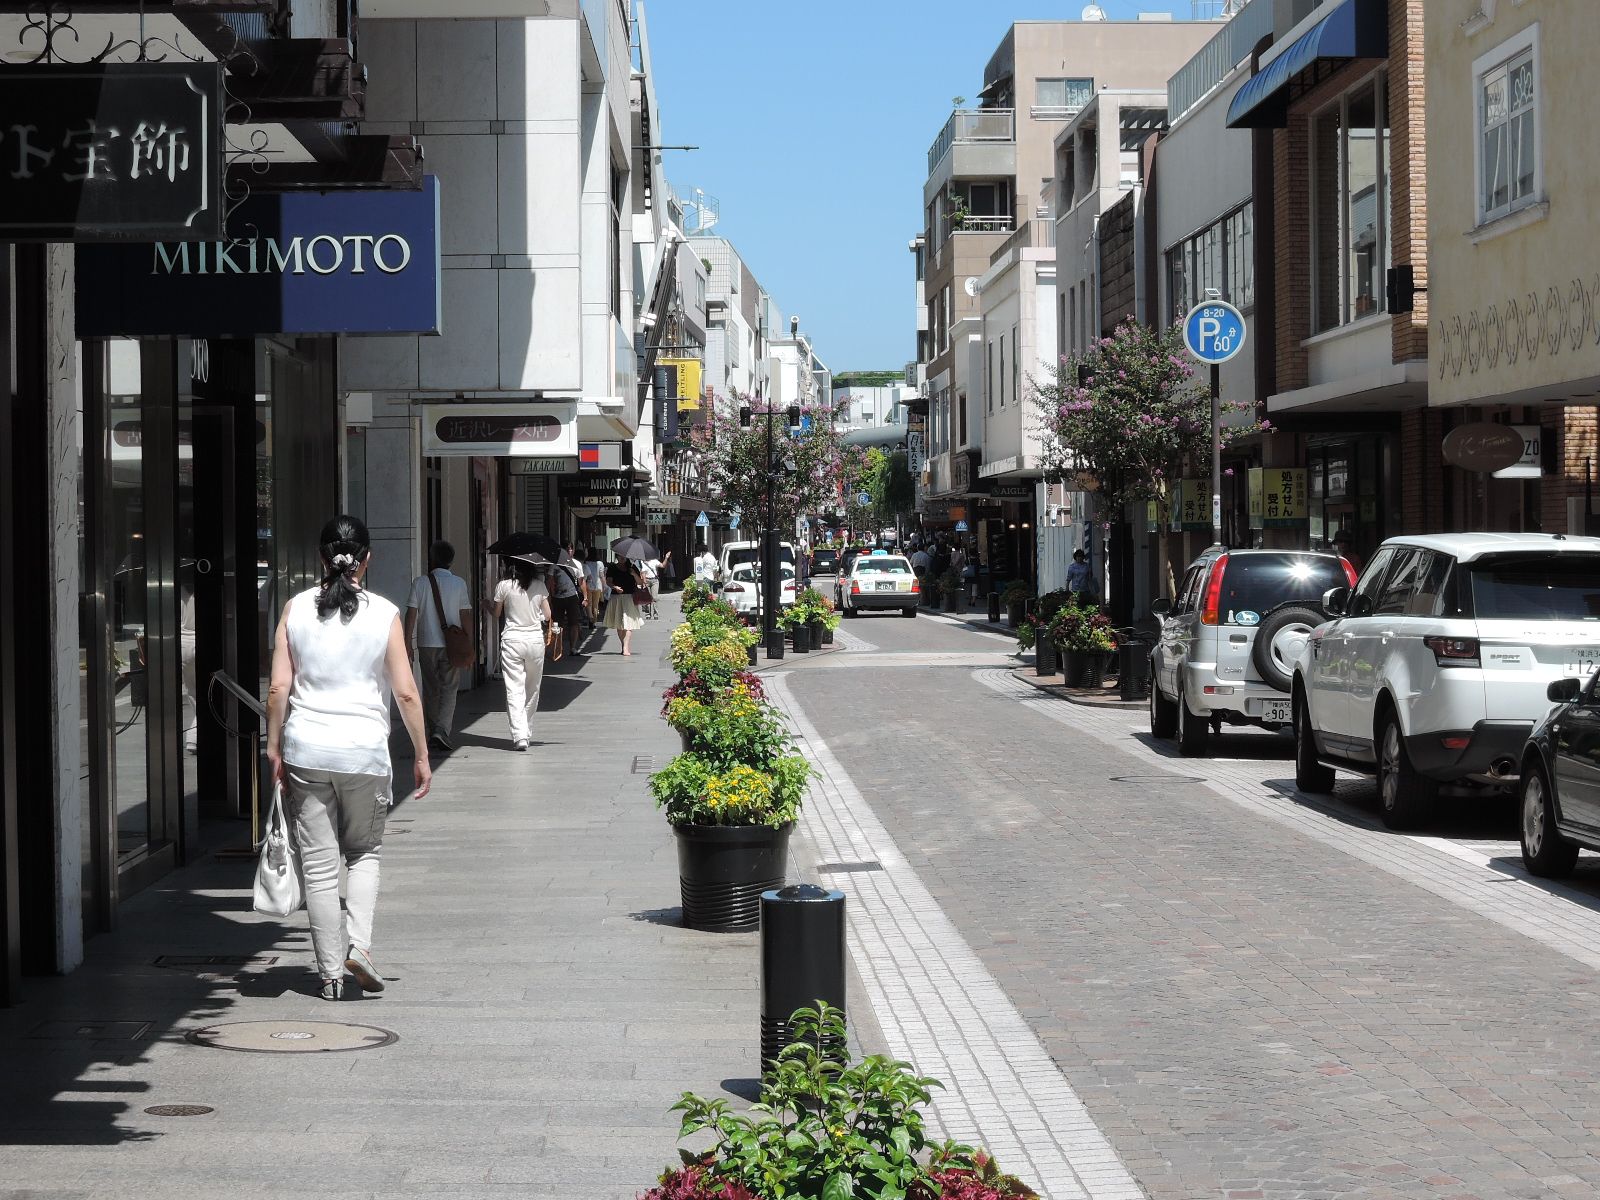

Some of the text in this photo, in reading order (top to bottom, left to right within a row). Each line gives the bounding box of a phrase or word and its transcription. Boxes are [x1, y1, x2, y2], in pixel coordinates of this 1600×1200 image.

[0, 118, 191, 183] ト宝飾
[151, 234, 411, 276] MIKIMOTO
[1203, 308, 1225, 318] 8-20
[1199, 317, 1220, 352] P
[1214, 336, 1230, 352] 60
[448, 420, 549, 440] 近沢レース店
[590, 478, 629, 490] MINATO
[999, 487, 1027, 495] AIGLE
[1281, 471, 1293, 517] 処方せん
[580, 496, 620, 505] Le Beau
[1184, 500, 1195, 521] 受付
[1267, 493, 1279, 517] 受付
